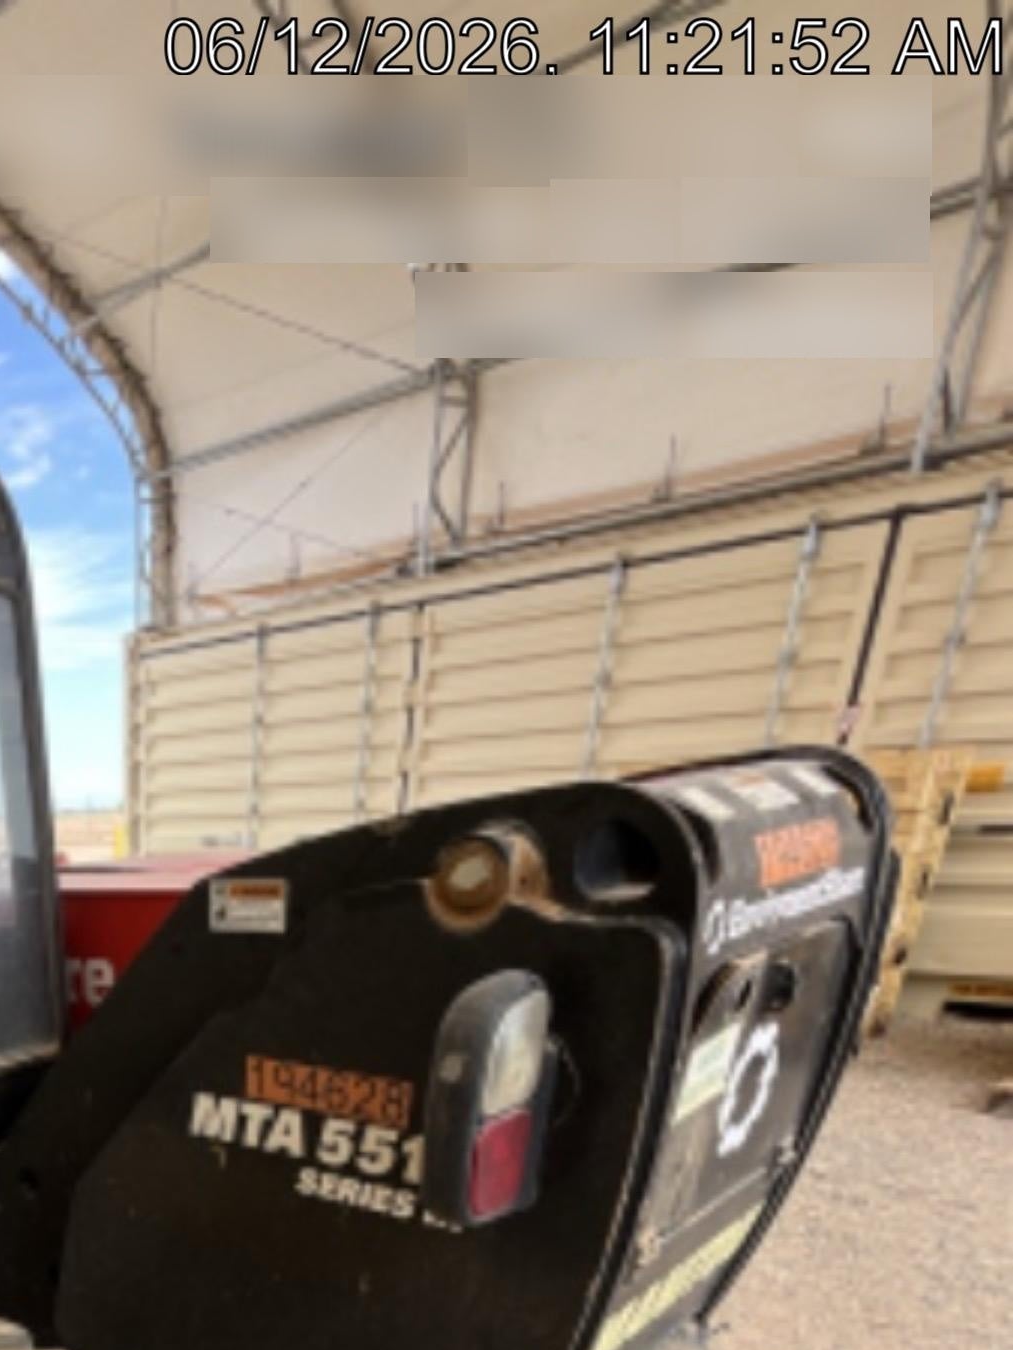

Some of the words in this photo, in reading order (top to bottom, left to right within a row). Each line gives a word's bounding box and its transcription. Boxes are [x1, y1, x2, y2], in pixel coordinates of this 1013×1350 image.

[191, 1091, 304, 1157] MTA
[316, 1118, 426, 1185] 551
[294, 1166, 415, 1218] SERIES
